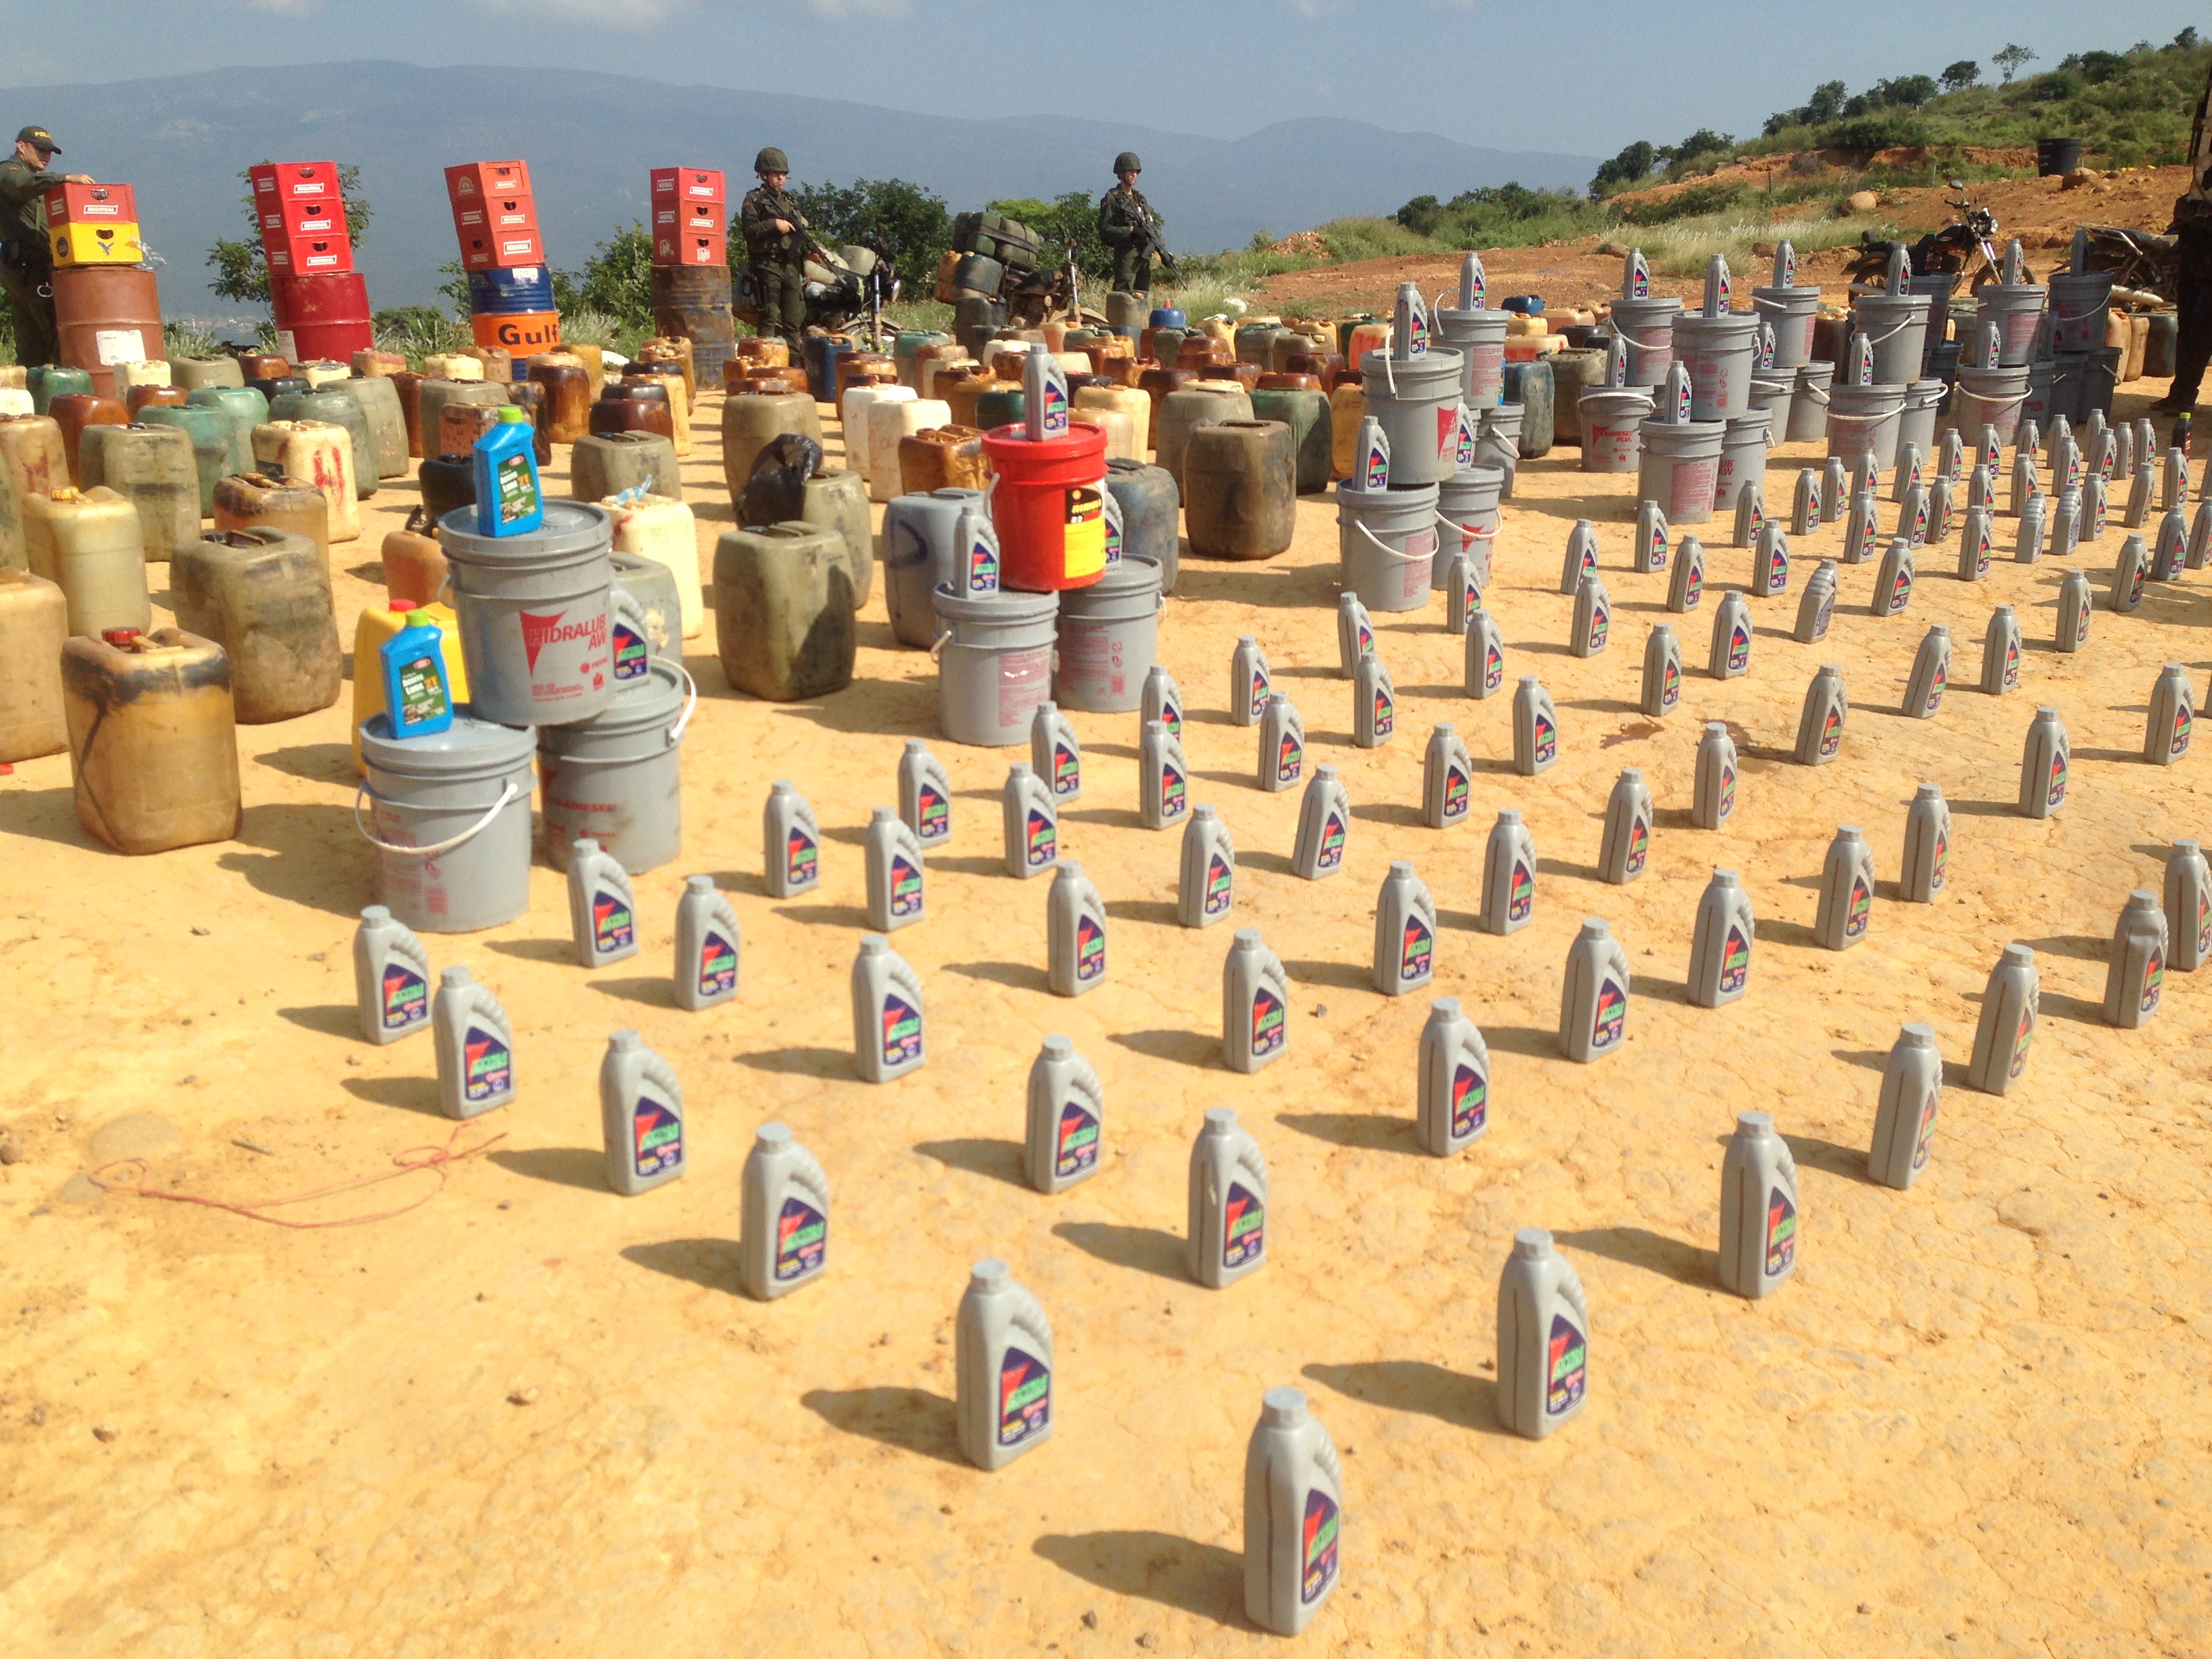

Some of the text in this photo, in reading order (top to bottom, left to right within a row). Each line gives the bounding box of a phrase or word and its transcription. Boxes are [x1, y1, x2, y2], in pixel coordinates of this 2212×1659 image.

[506, 243, 529, 251] REGIONAL
[498, 323, 558, 346] Gulf
[528, 613, 607, 647] HIDRALUB
[588, 631, 606, 651] AW
